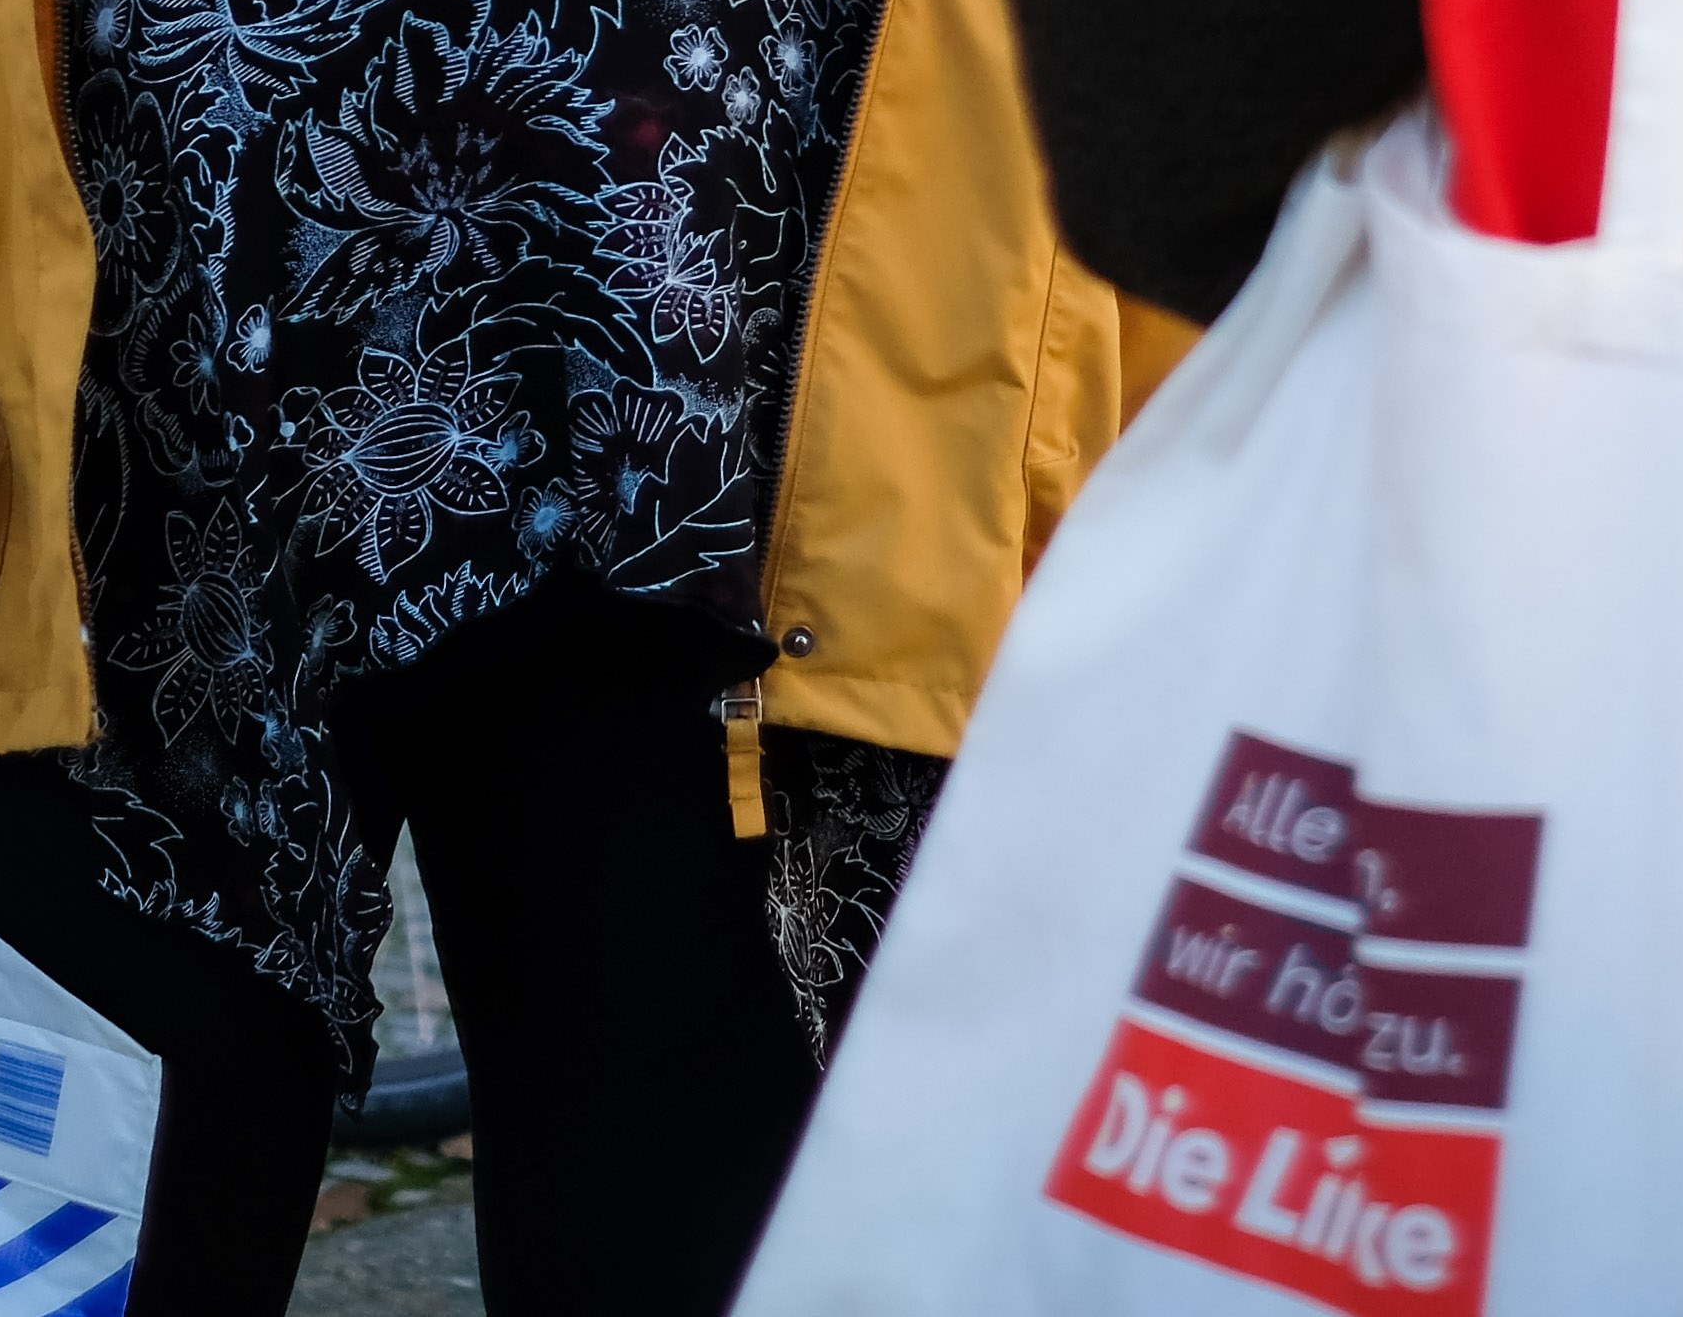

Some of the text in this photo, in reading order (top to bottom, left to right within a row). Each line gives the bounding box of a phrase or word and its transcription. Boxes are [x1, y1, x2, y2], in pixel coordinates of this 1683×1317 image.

[1221, 770, 1349, 864] Alle
[1164, 922, 1260, 998] wir
[1083, 1070, 1233, 1214] Die
